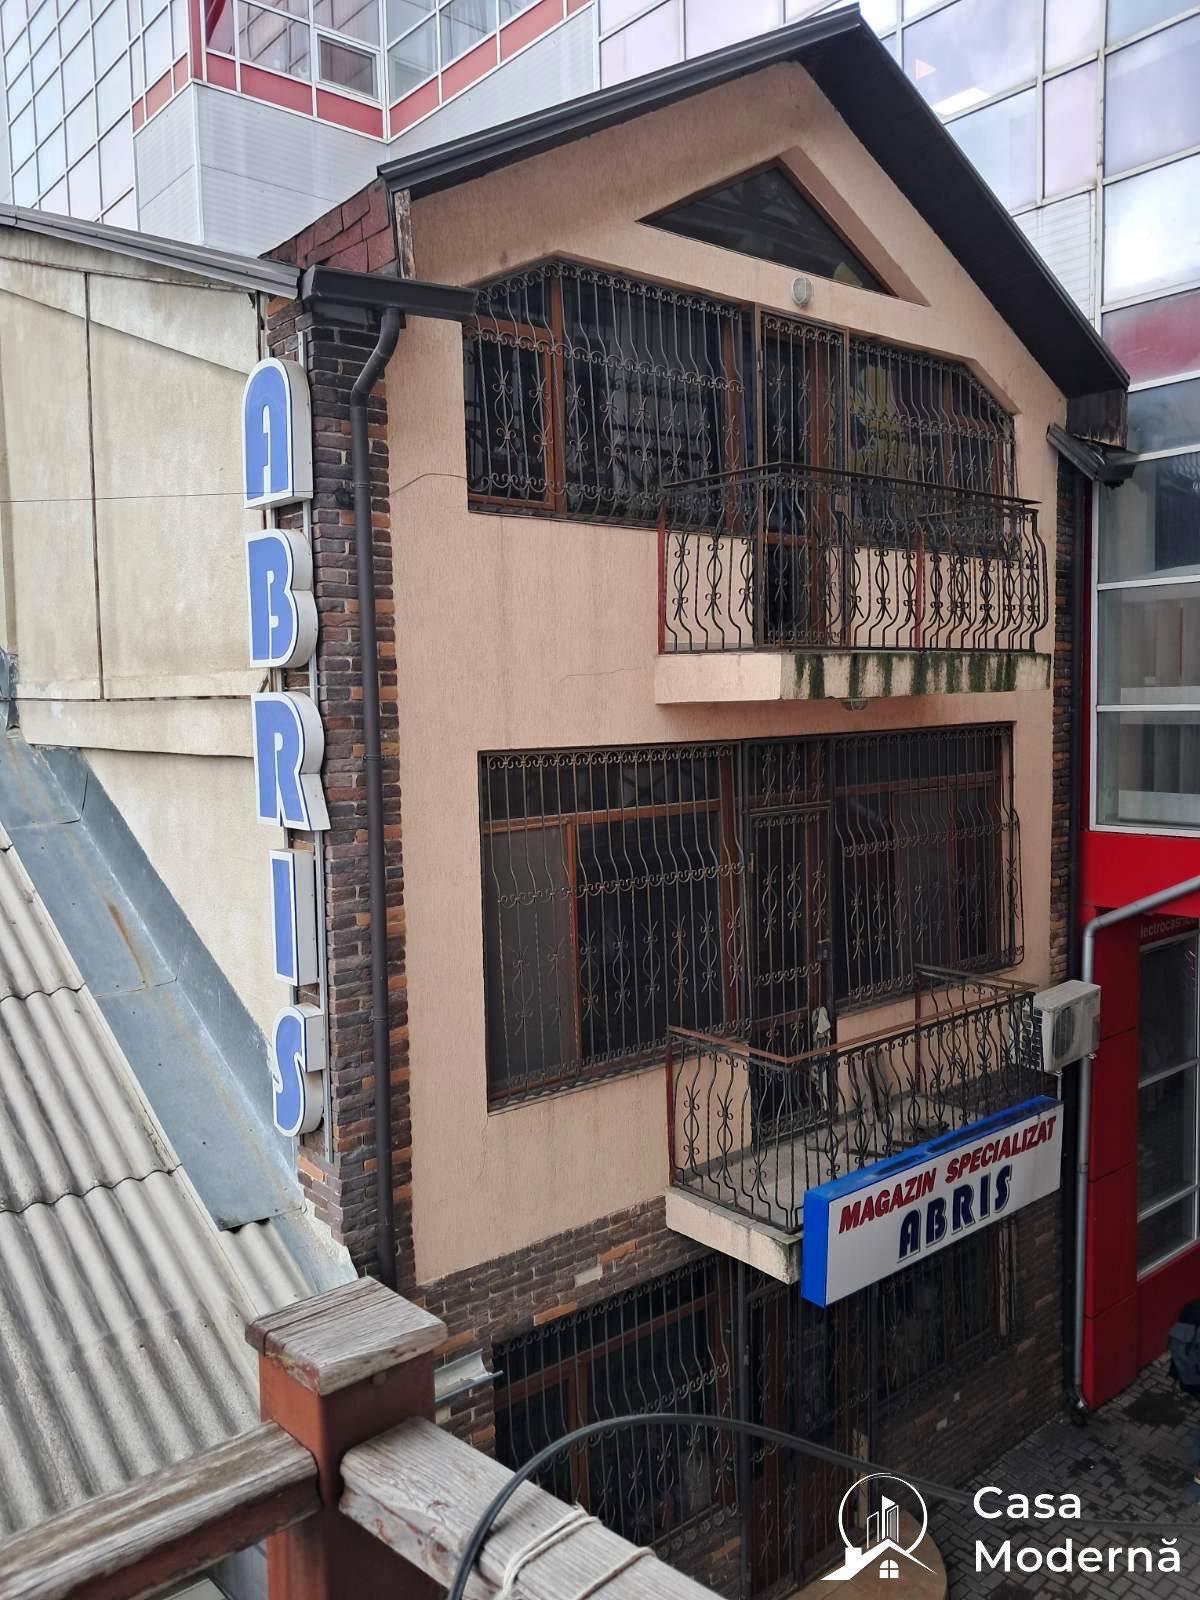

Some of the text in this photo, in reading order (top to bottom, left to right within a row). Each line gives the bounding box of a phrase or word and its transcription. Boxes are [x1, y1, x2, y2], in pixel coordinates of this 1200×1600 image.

[242, 357, 324, 1137] ABRIS
[839, 1116, 1057, 1234] MAGAZIN SPECIALIZAT
[897, 1164, 1012, 1261] ABRIS
